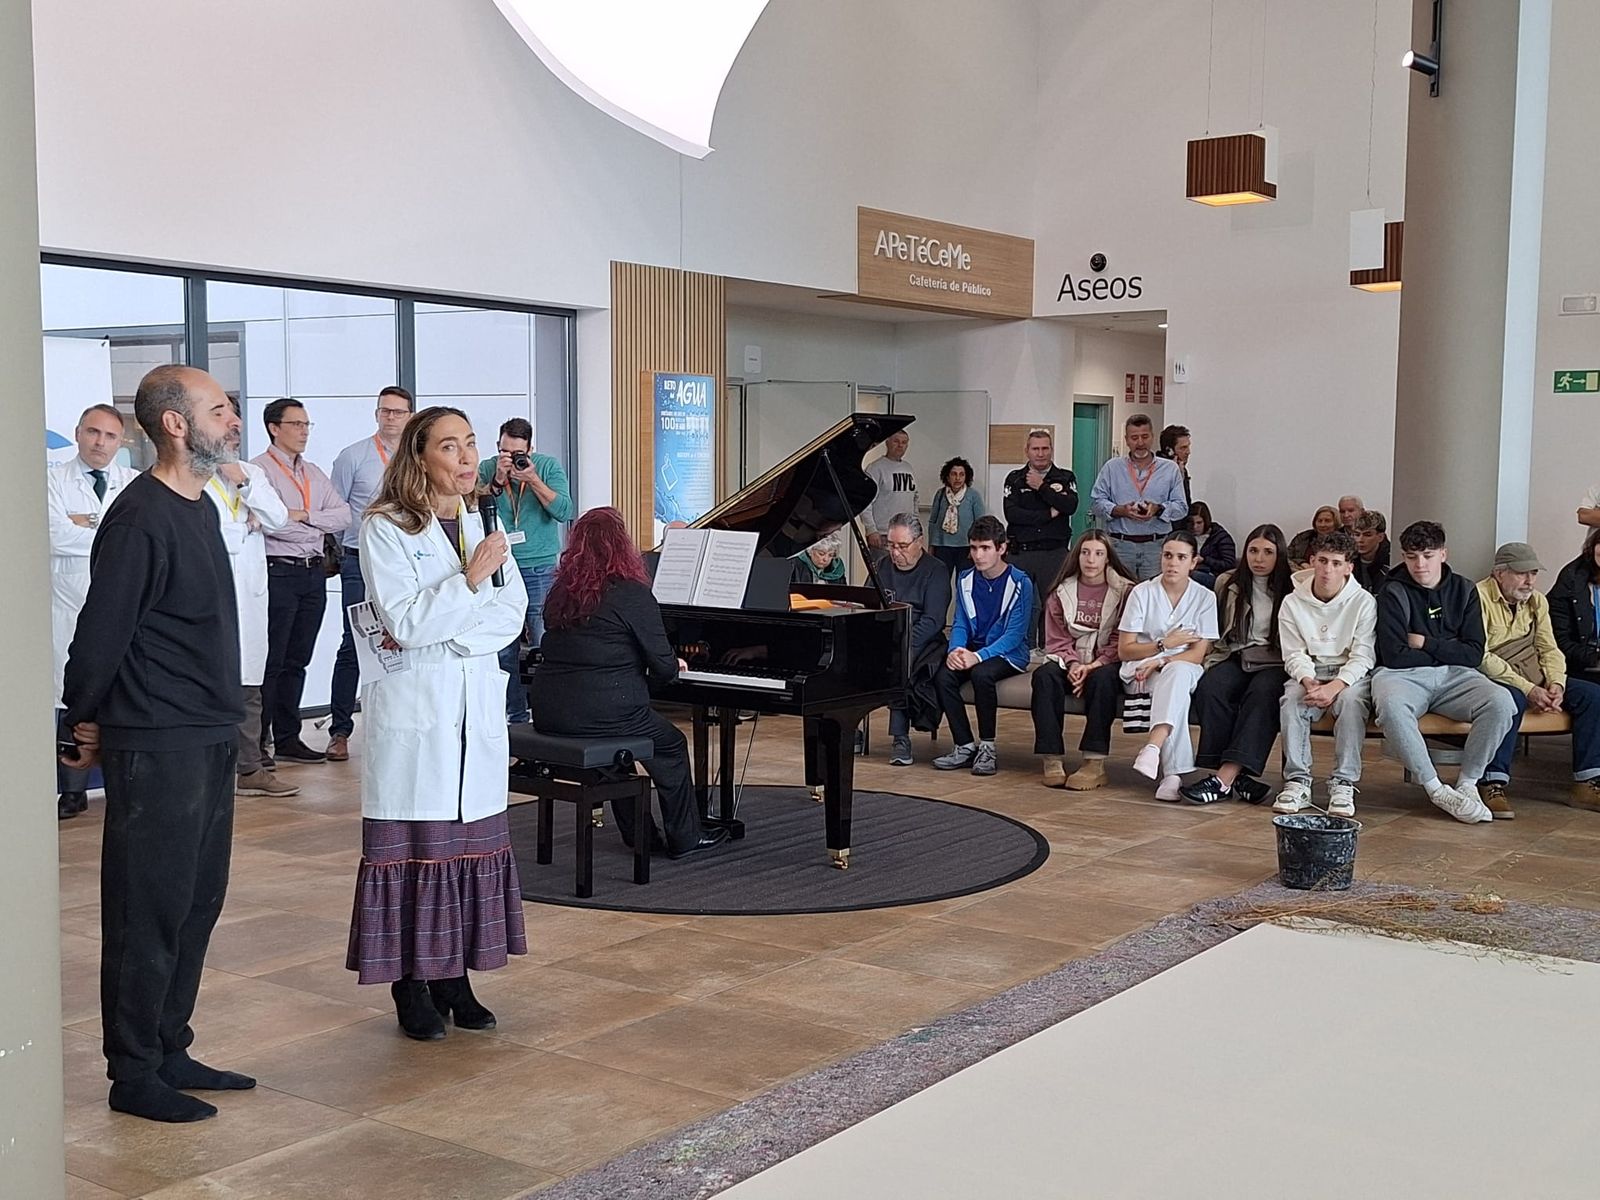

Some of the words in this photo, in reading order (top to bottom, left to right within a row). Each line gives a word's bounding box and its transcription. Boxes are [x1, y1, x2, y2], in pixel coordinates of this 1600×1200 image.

[909, 273, 948, 290] Cafetería
[949, 280, 960, 292] de
[961, 281, 992, 296] Público
[1056, 273, 1143, 302] Aseos
[676, 379, 707, 408] AGUA
[892, 472, 916, 492] NYC
